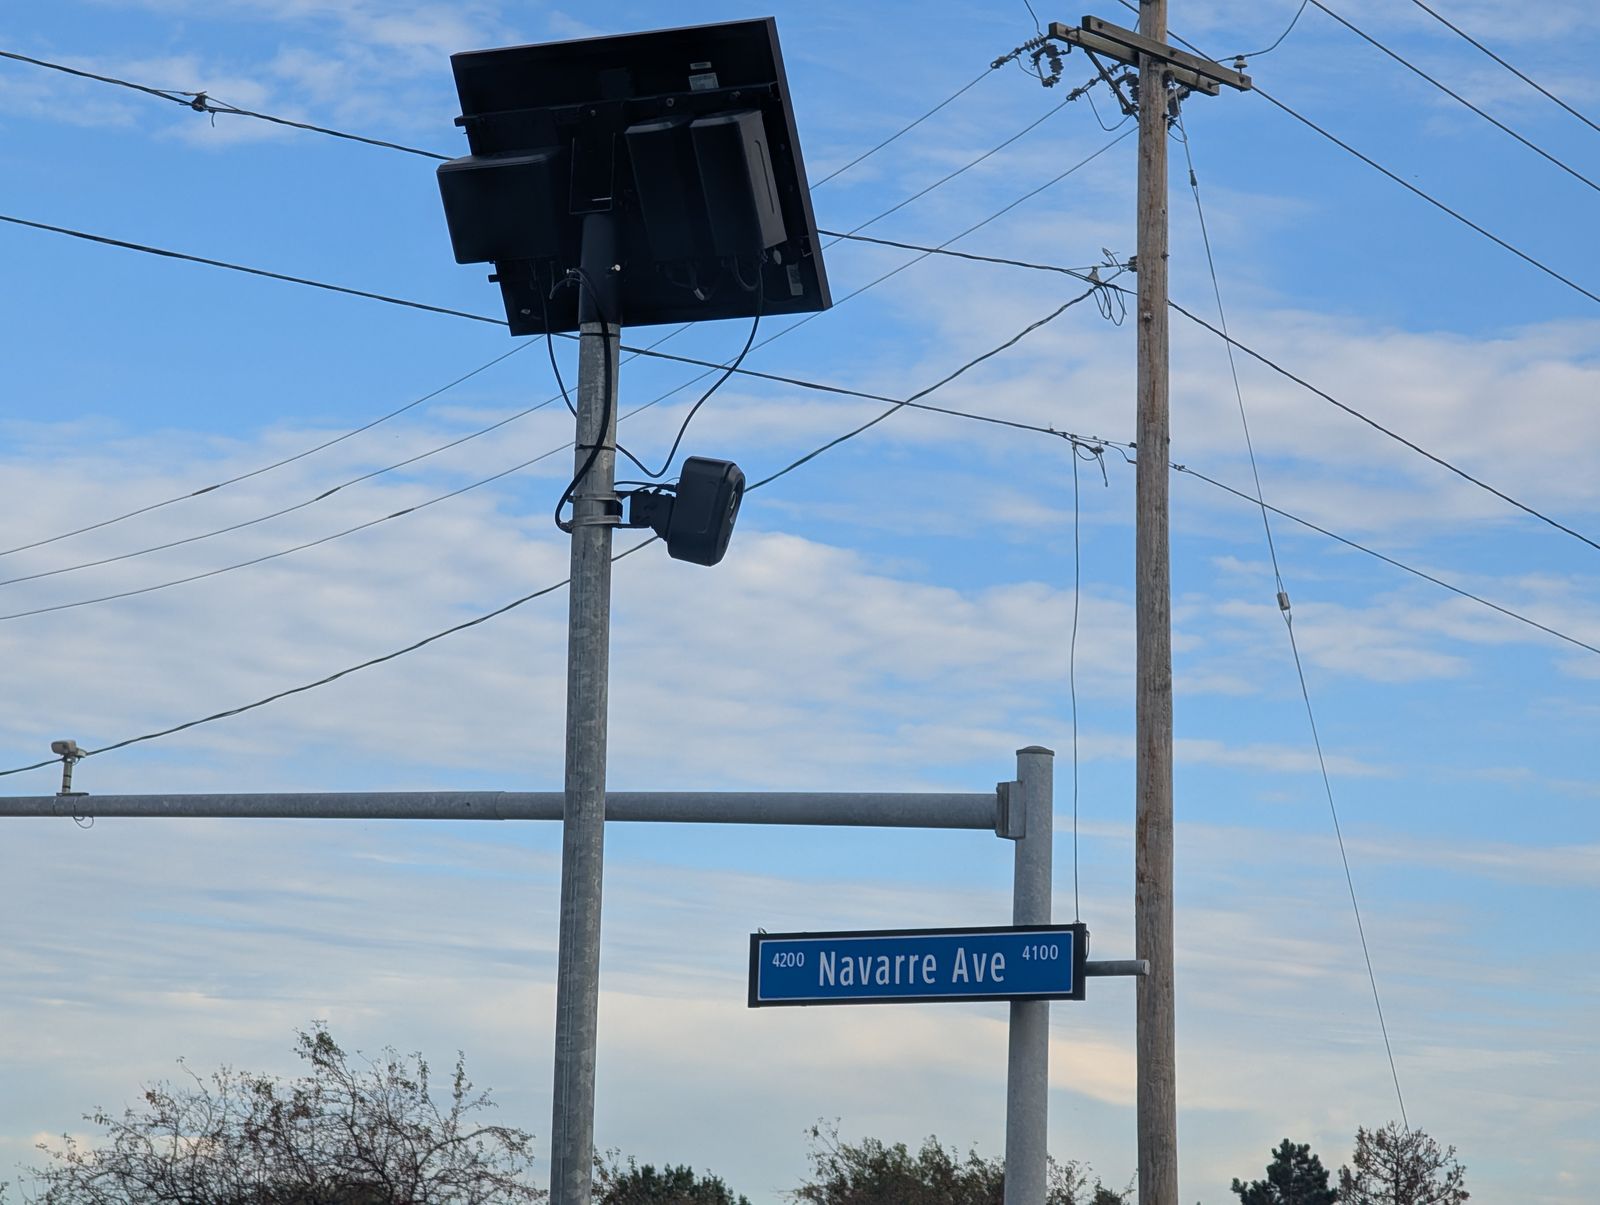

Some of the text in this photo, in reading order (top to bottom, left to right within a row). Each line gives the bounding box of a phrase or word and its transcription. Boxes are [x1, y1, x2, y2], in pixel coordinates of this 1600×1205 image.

[772, 952, 805, 968] 4200
[1022, 944, 1059, 961] 4100
[818, 946, 1006, 986] Navarre Ave
